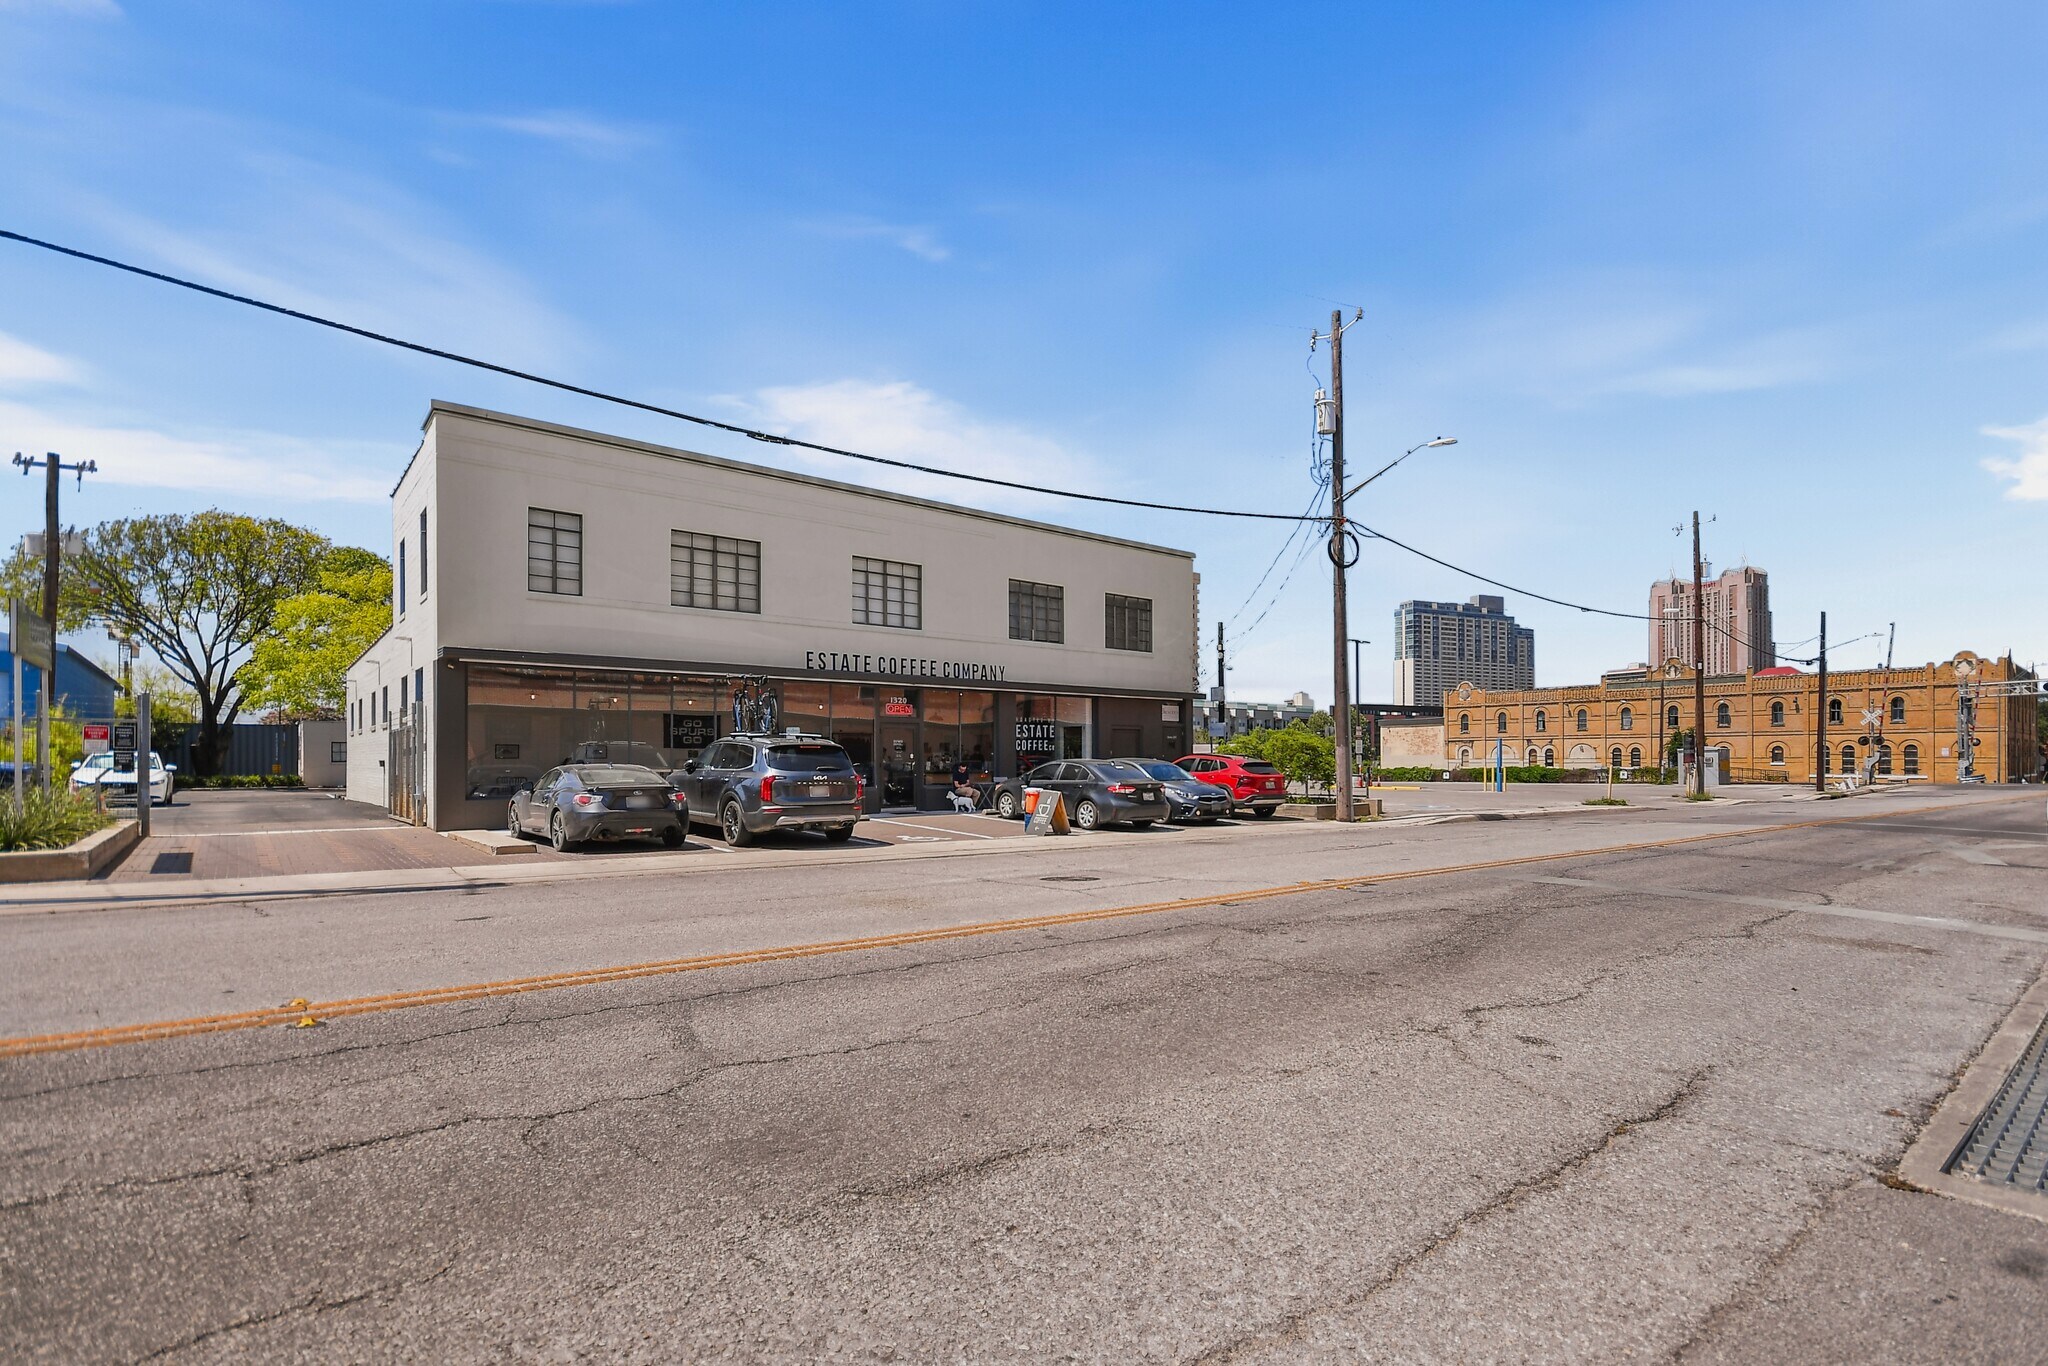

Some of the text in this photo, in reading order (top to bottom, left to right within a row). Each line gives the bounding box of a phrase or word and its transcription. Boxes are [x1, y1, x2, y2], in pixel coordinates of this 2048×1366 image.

[806, 651, 1006, 682] ESTATE COFFEE COMPANY
[887, 705, 911, 713] OPEN
[683, 719, 702, 727] GO
[671, 727, 714, 736] SPURS
[1015, 724, 1055, 738] ESTATE
[683, 736, 702, 744] GO
[1015, 739, 1048, 751] COFFEE
[1033, 816, 1048, 825] COFFEE
